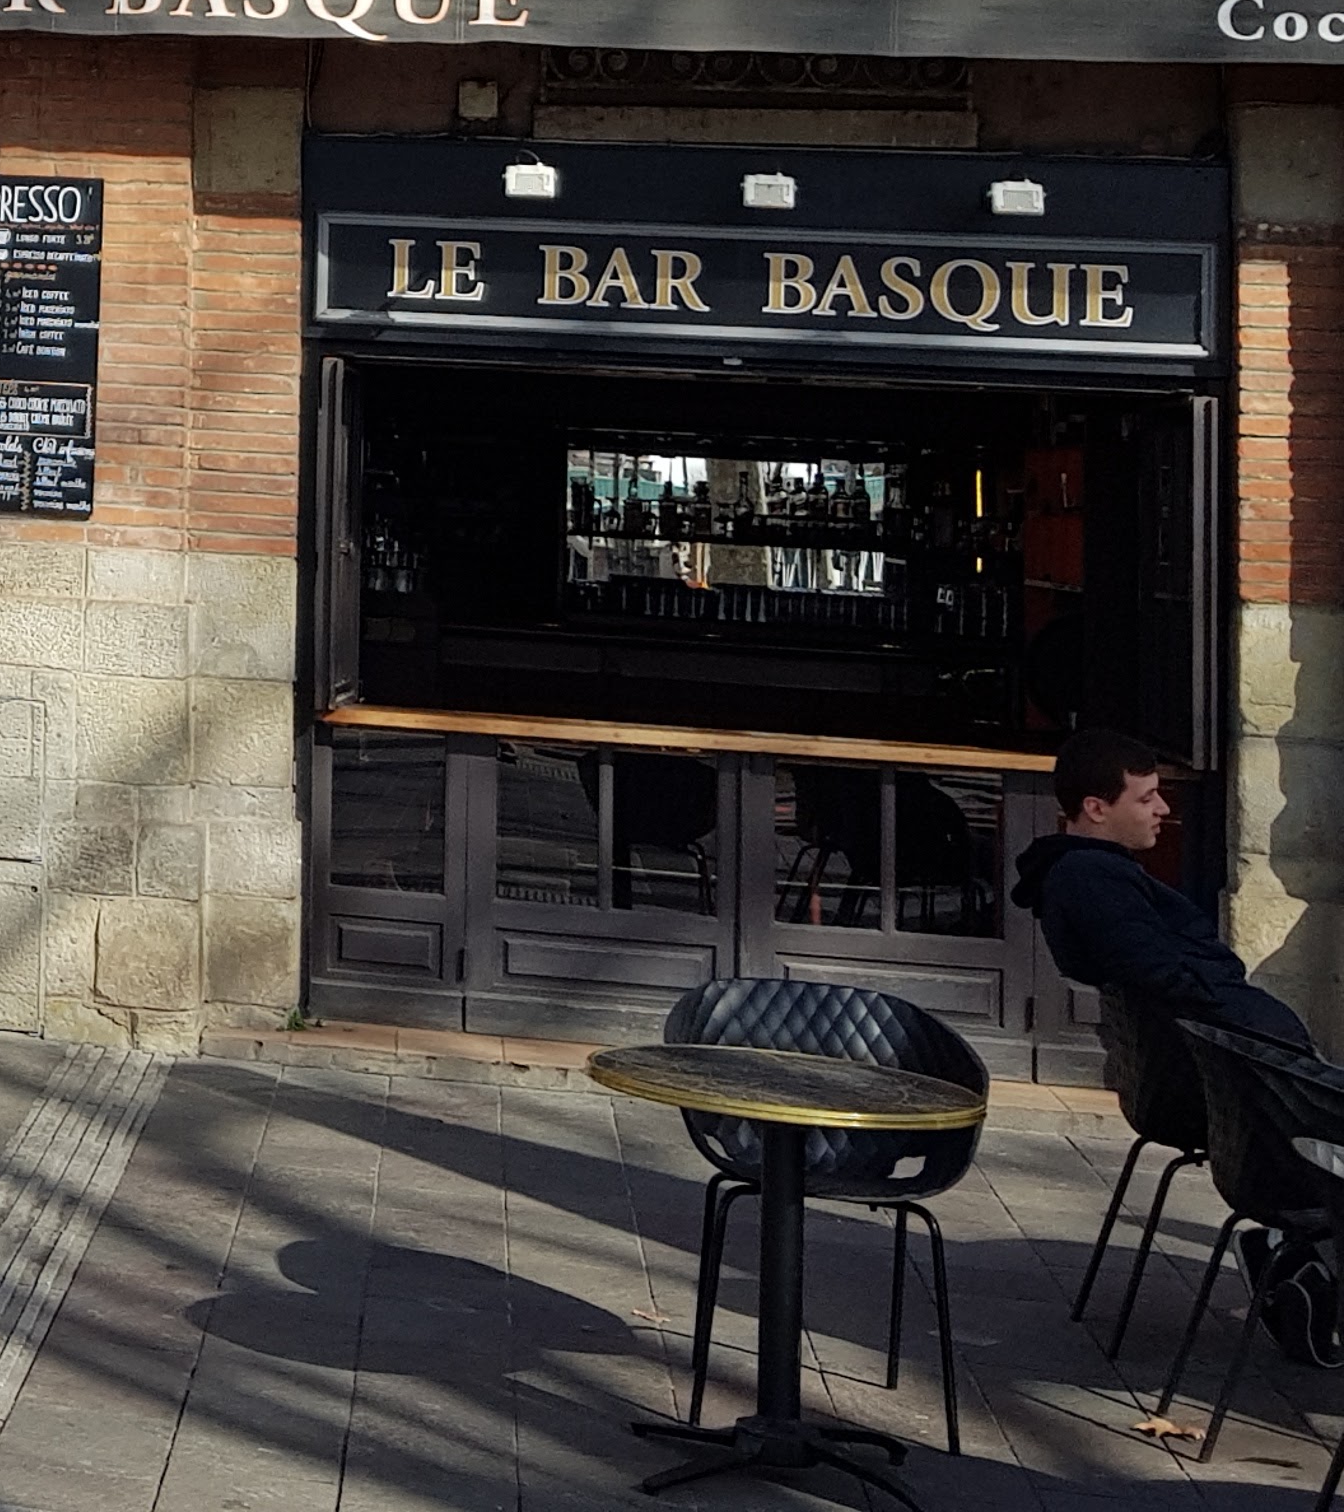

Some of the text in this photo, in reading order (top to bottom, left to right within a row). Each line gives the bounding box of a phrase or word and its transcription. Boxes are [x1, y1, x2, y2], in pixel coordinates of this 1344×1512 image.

[387, 238, 1134, 331] LE BAR BASQUE
